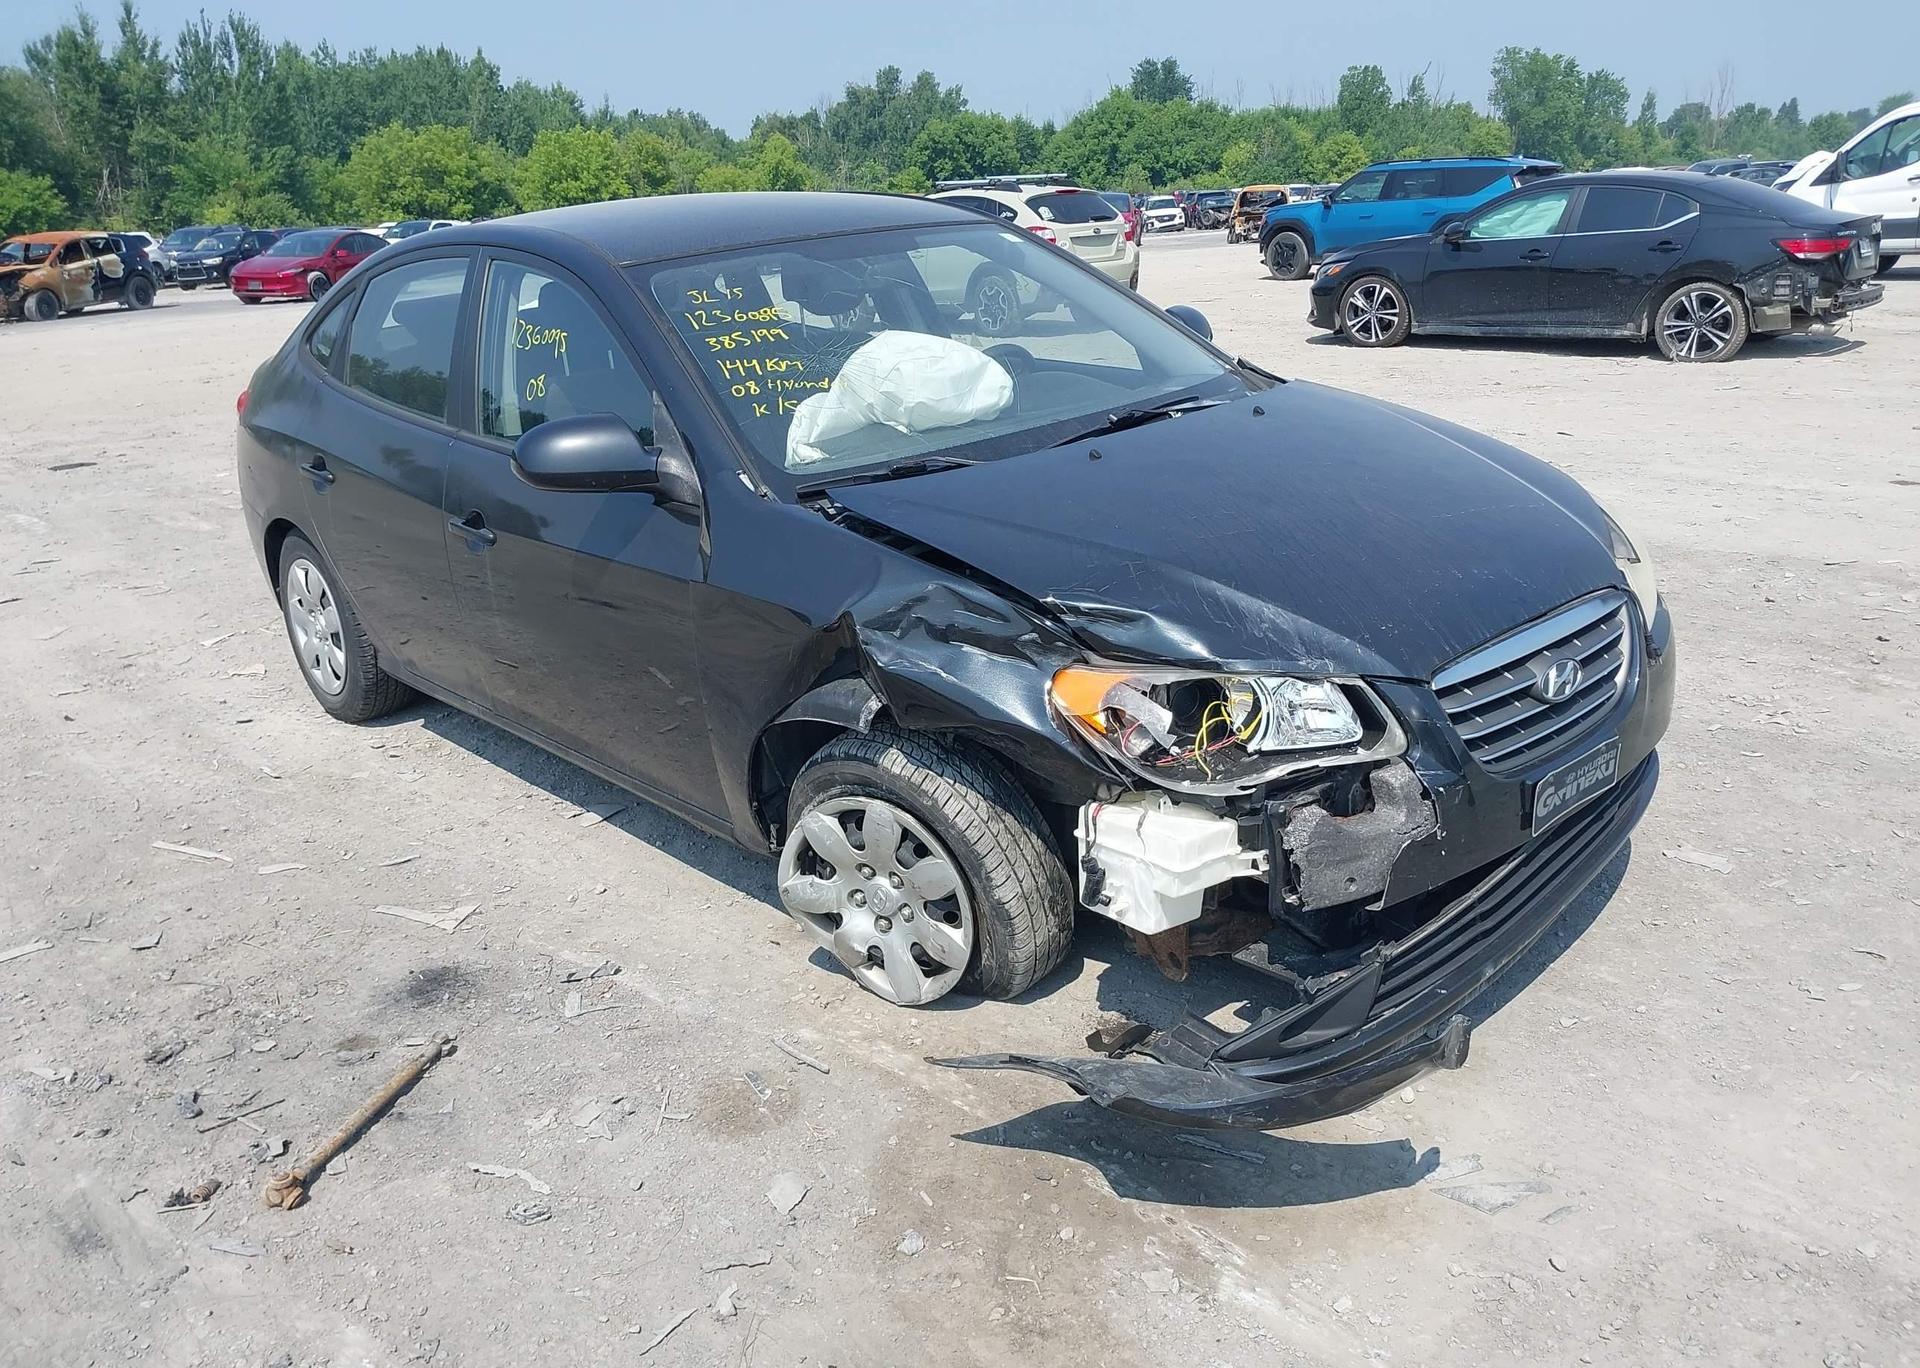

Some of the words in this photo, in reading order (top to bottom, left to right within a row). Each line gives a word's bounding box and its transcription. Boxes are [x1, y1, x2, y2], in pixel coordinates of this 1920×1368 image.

[704, 328, 789, 351] 385199
[526, 373, 546, 401] 08
[731, 381, 760, 397] 08
[1577, 748, 1617, 778] HYUNDAI
